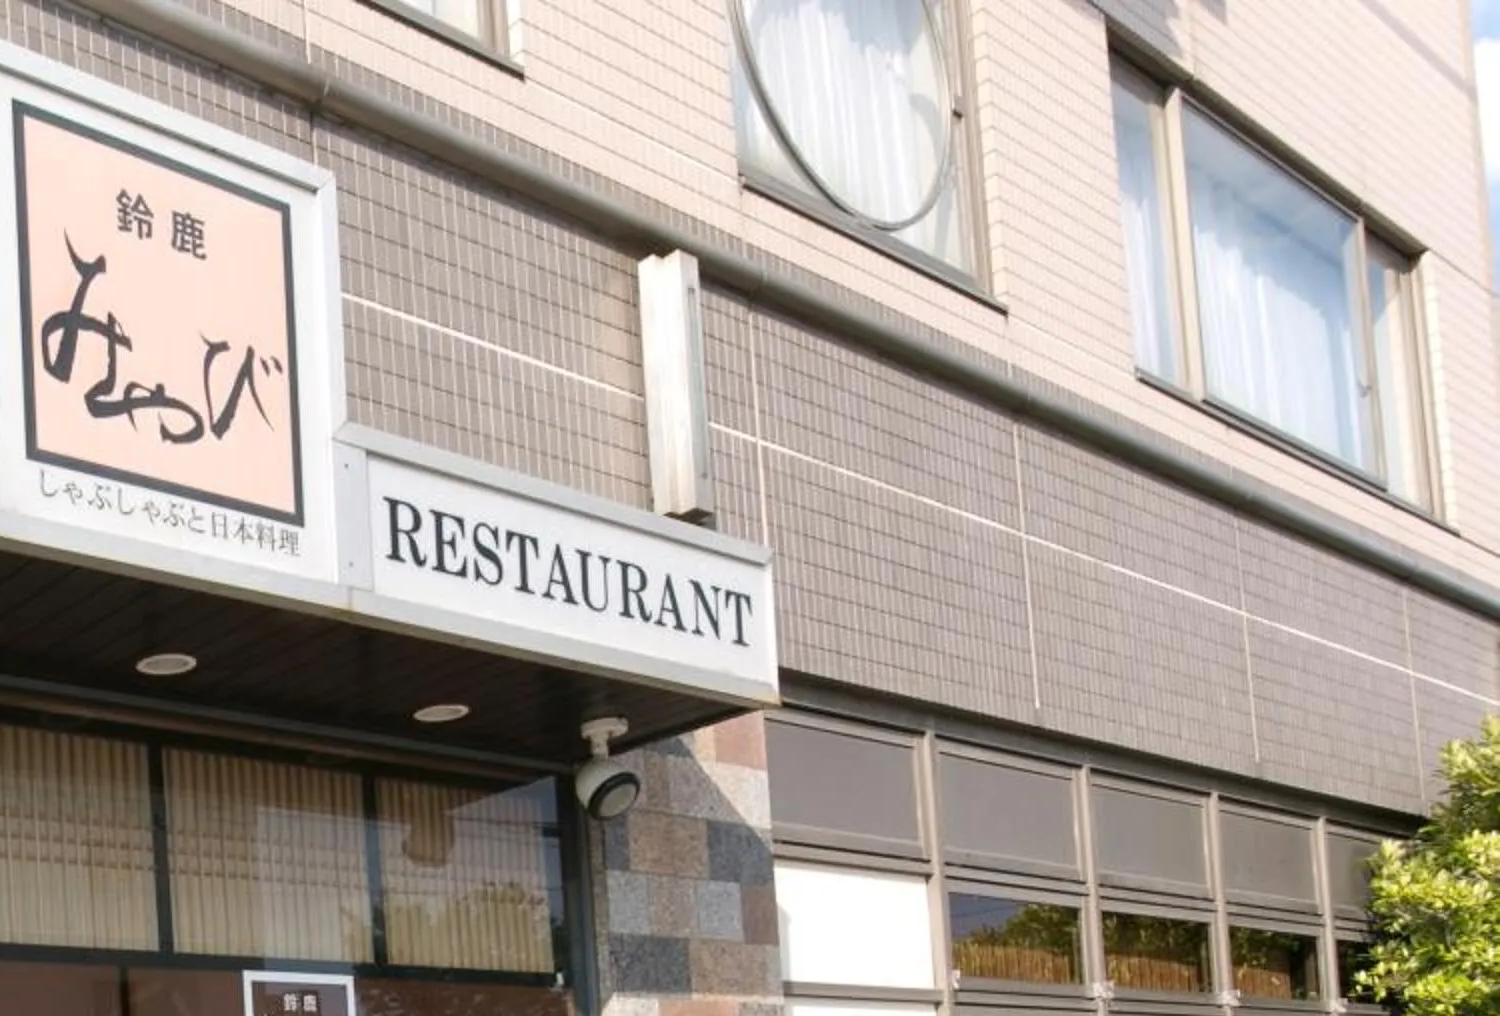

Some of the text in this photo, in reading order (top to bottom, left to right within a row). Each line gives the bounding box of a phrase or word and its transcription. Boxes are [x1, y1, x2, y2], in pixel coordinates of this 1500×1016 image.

[115, 188, 208, 261] 鈴鹿
[39, 469, 301, 557] しゃぶしゃぶと日本料理
[382, 495, 754, 647] RESTAURANT
